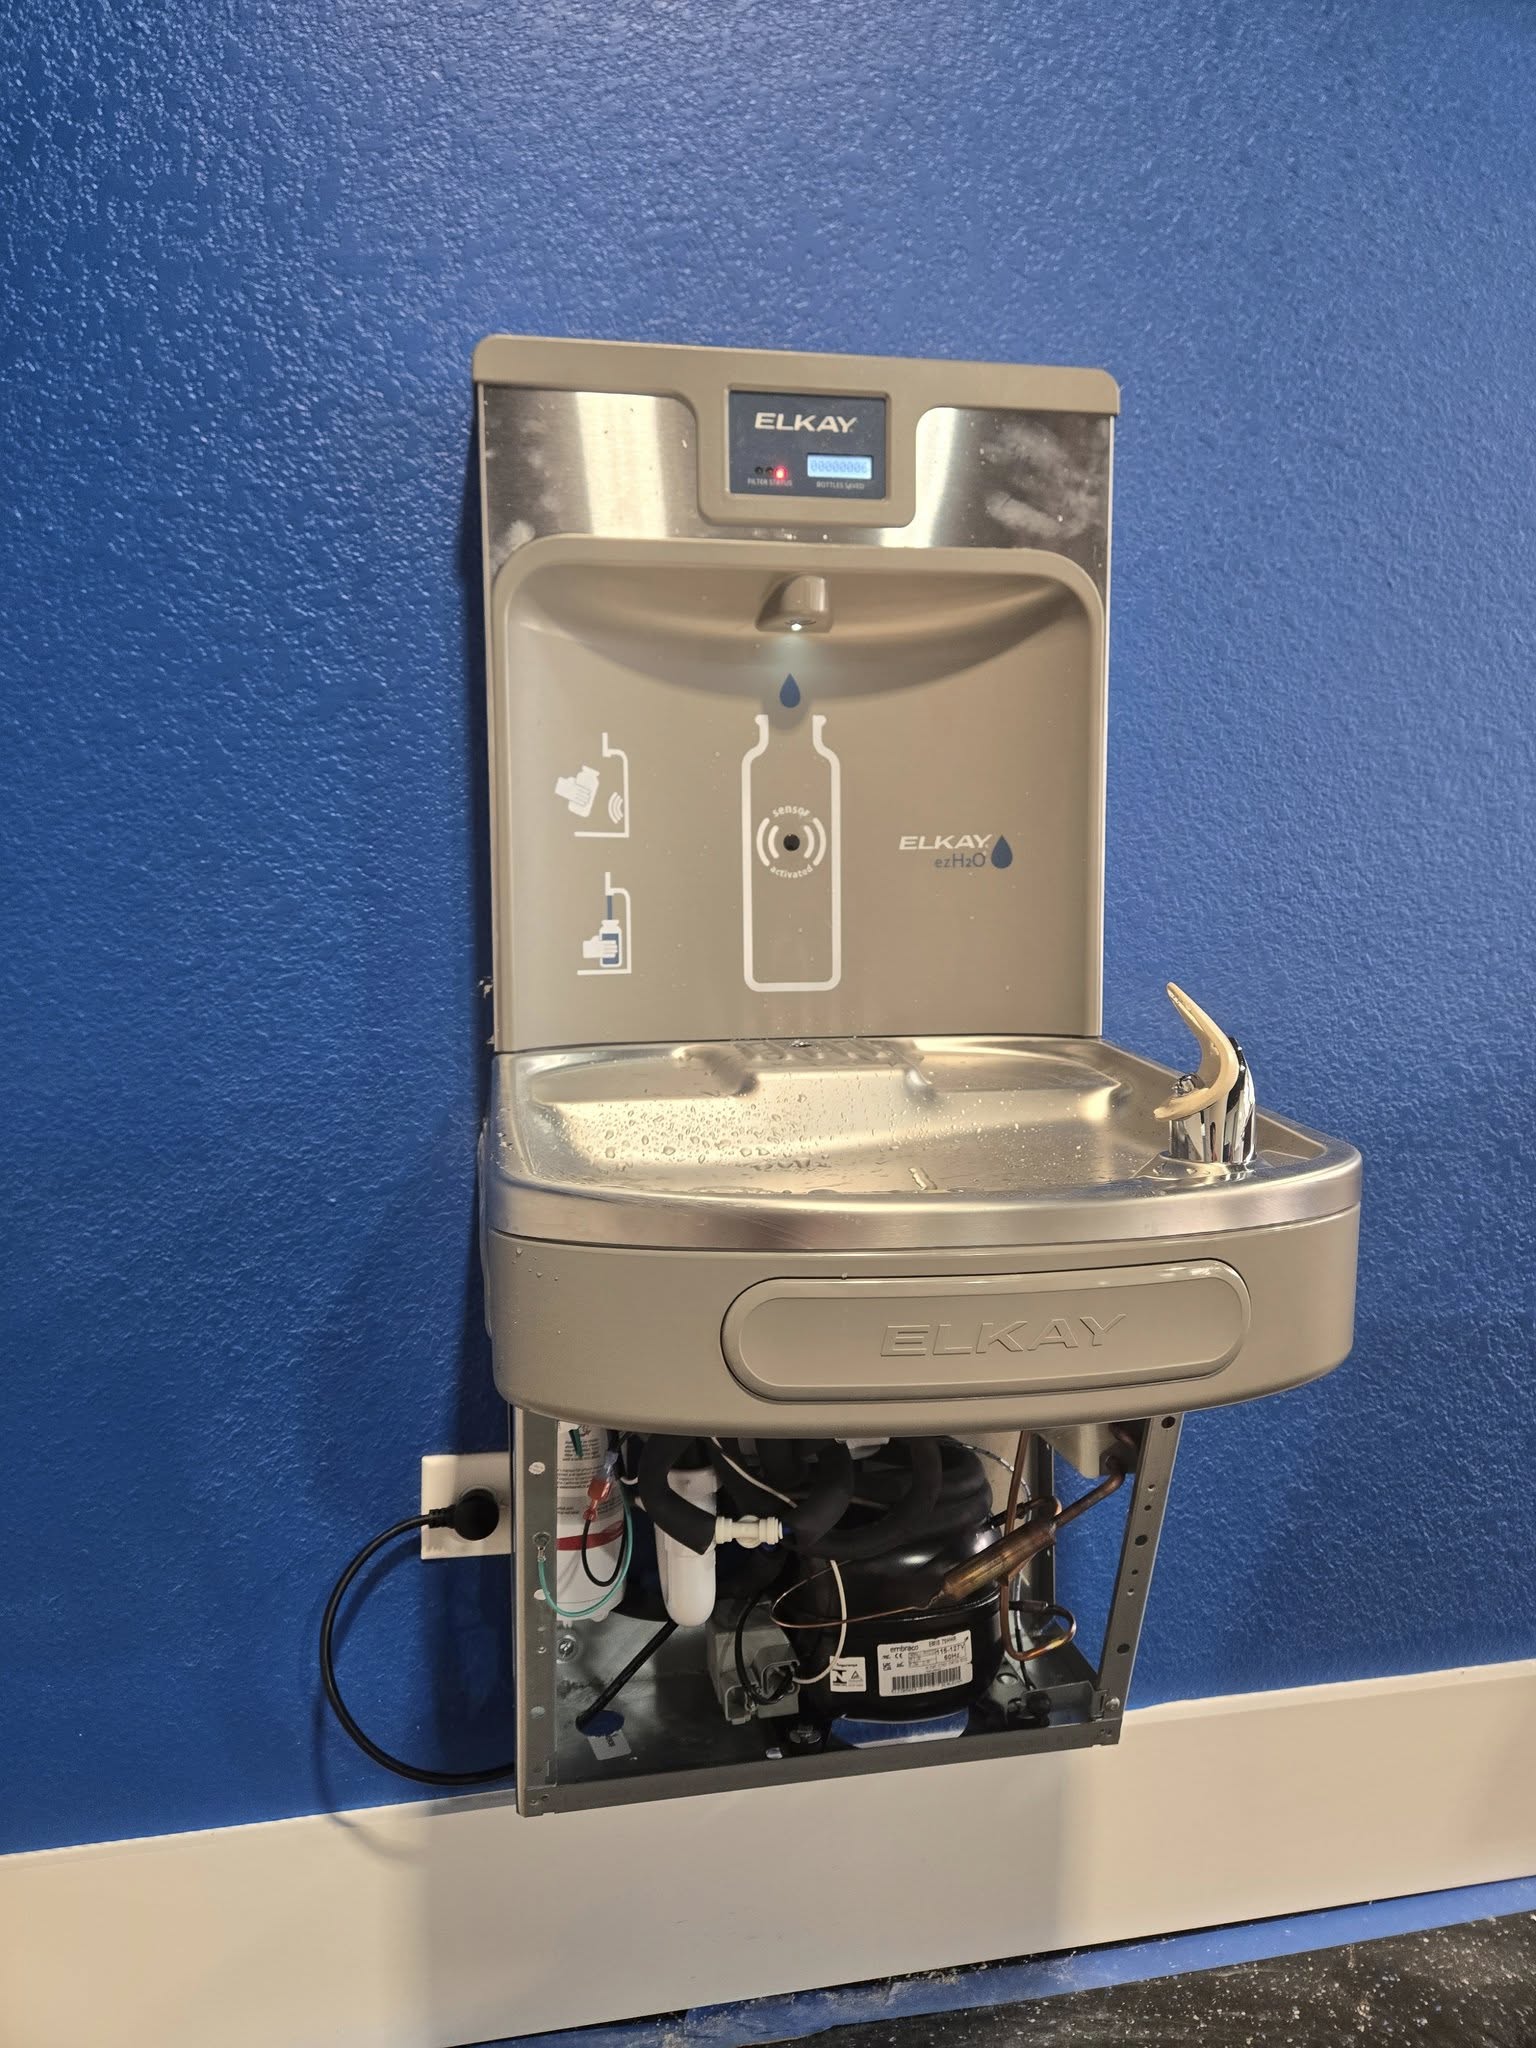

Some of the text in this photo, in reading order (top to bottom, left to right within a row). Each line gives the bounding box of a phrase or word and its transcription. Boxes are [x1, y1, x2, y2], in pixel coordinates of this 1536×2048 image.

[754, 412, 858, 433] ELKAY
[747, 478, 769, 486] FILTER
[816, 480, 865, 490] BOTTLES SAVED
[772, 804, 811, 818] sensor
[899, 834, 993, 850] ELKAY
[770, 864, 814, 879] activated
[880, 1313, 1127, 1357] ELKAY
[890, 1644, 919, 1653] embraco
